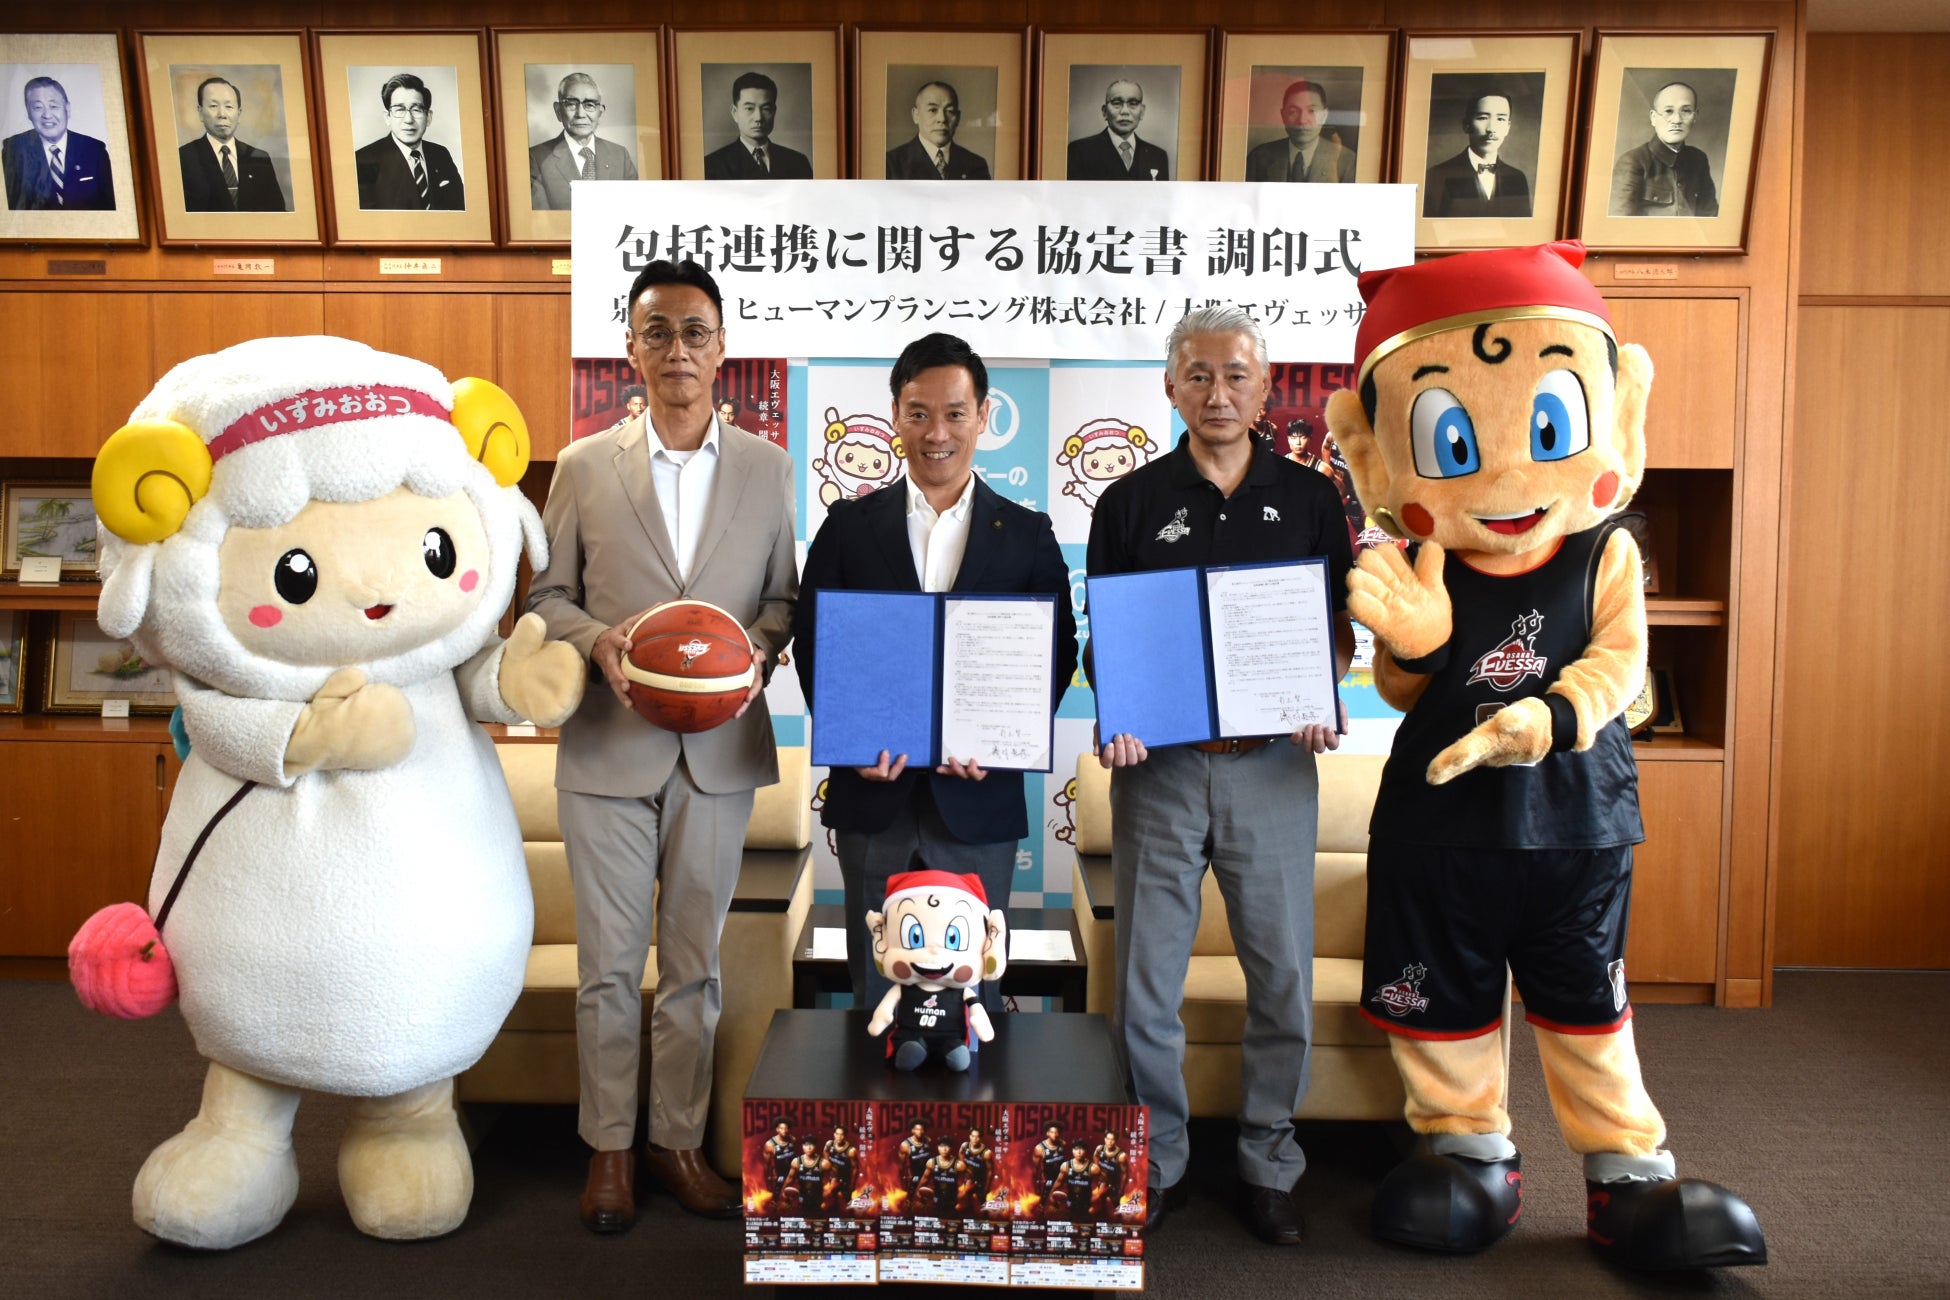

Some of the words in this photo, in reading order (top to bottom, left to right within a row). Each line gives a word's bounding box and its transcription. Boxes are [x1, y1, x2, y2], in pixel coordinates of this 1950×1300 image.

[615, 223, 1189, 277] 包括連携に関する協定書
[1207, 226, 1363, 278] 調印式
[738, 294, 1147, 326] ヒューマンプランニング株式会社
[1174, 297, 1367, 327] 大エヴェッサ
[259, 391, 412, 433] いずみおおつ
[769, 369, 781, 441] 大阪エヴェッサ
[1475, 651, 1544, 678] EVESSA
[1506, 652, 1531, 660] OSAKA
[919, 1015, 938, 1027] 00
